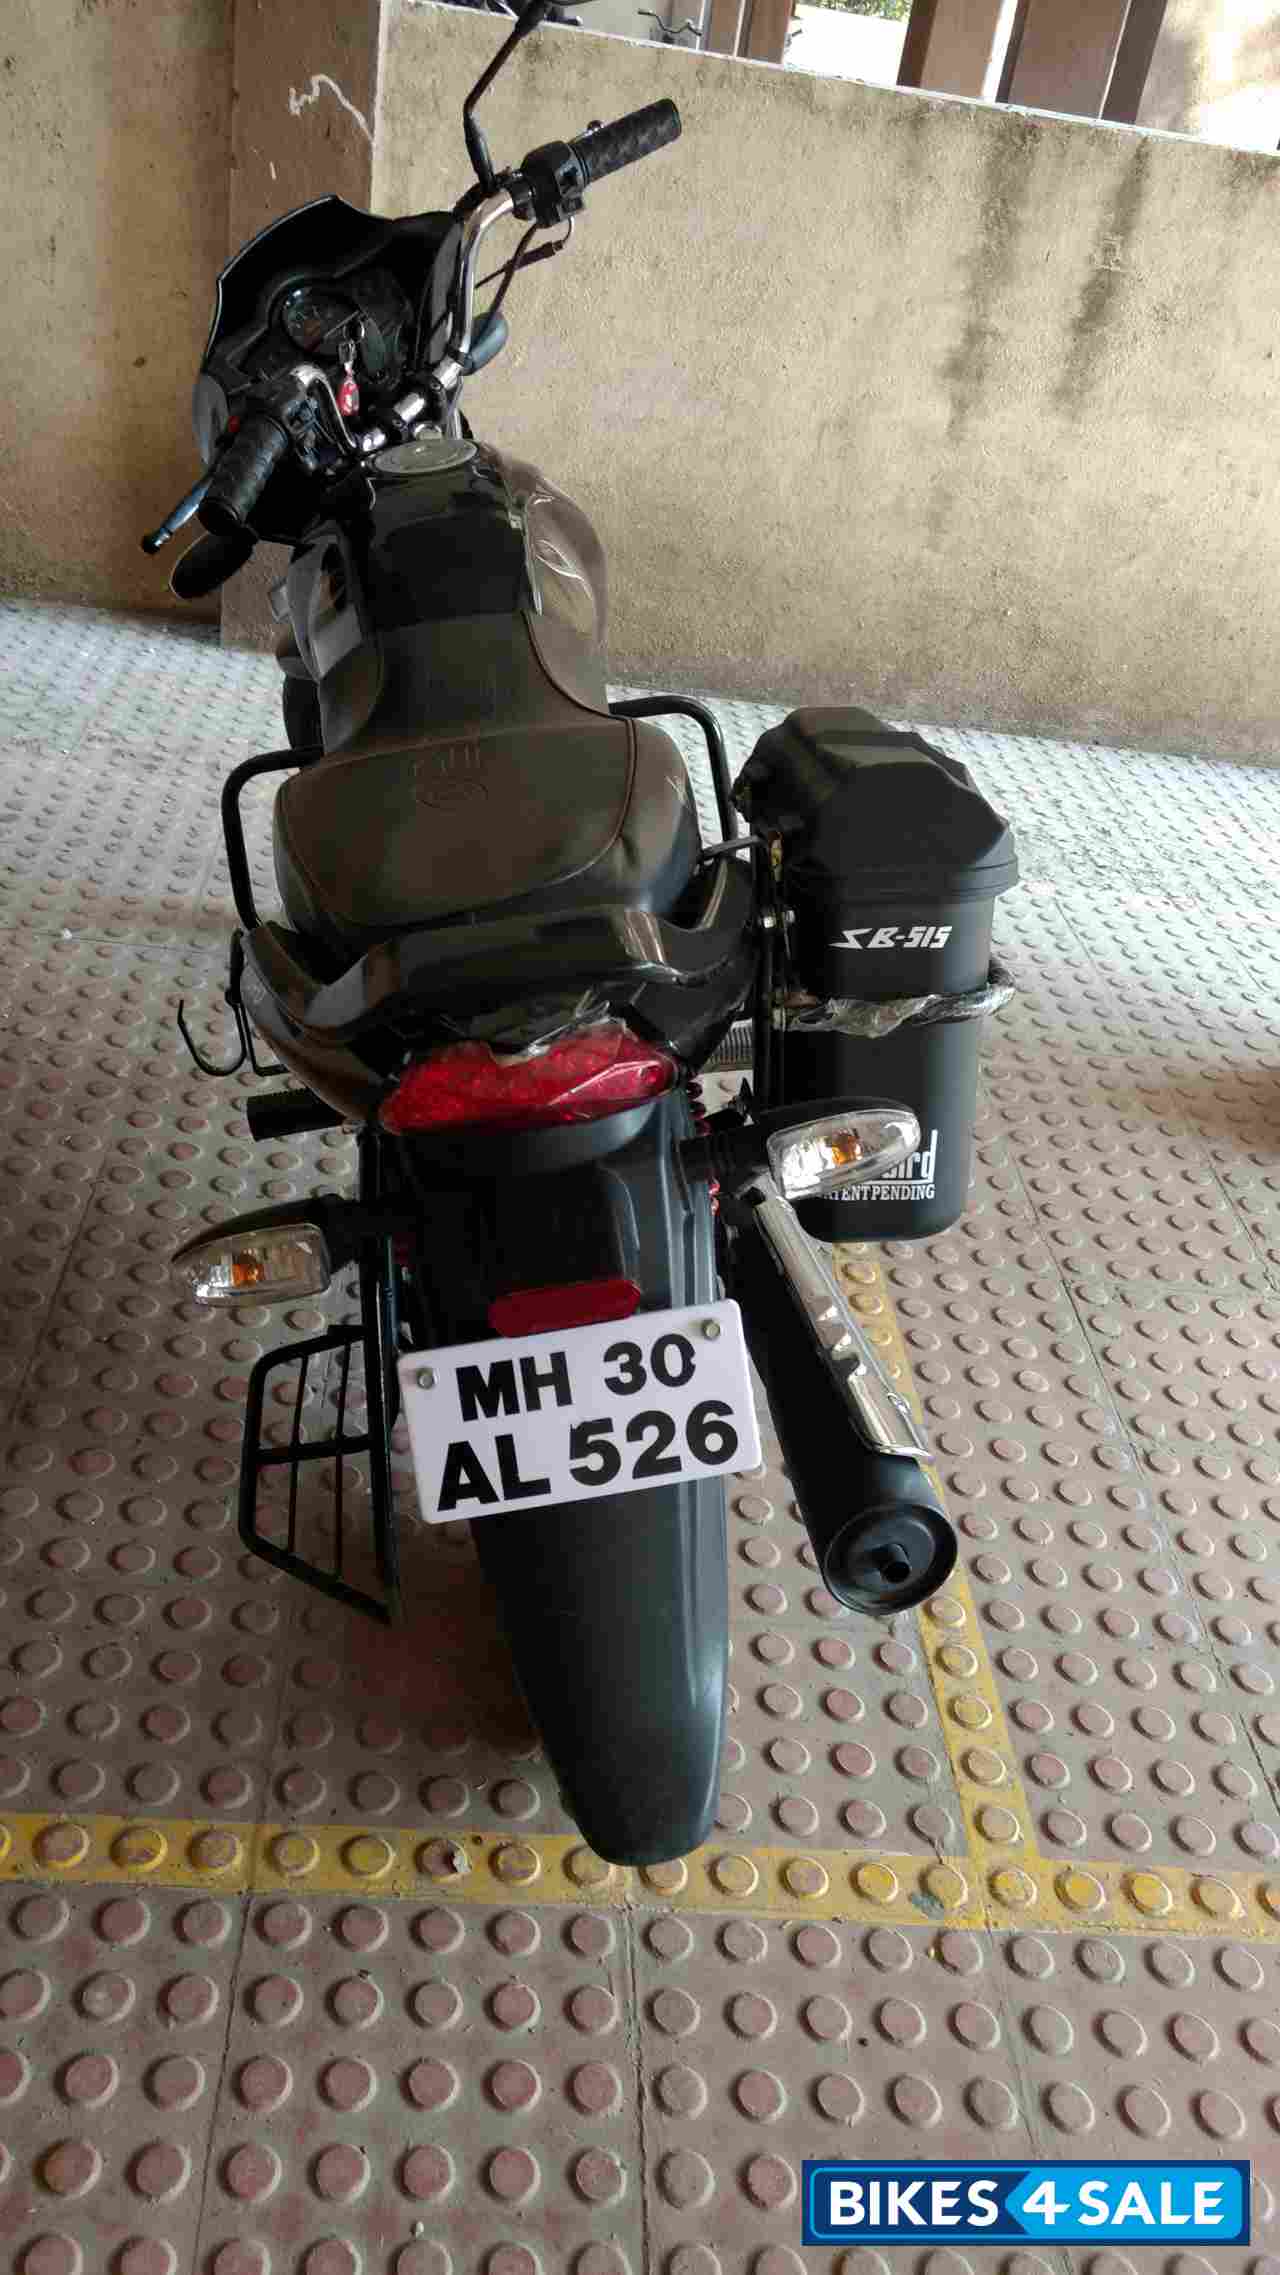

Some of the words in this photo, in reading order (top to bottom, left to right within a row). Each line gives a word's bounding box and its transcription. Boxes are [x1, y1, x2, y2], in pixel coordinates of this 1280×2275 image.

[827, 926, 953, 949] SB-515
[455, 1351, 573, 1422] MH
[603, 1333, 696, 1396] 30
[437, 1434, 552, 1512] AL
[569, 1399, 738, 1486] 526
